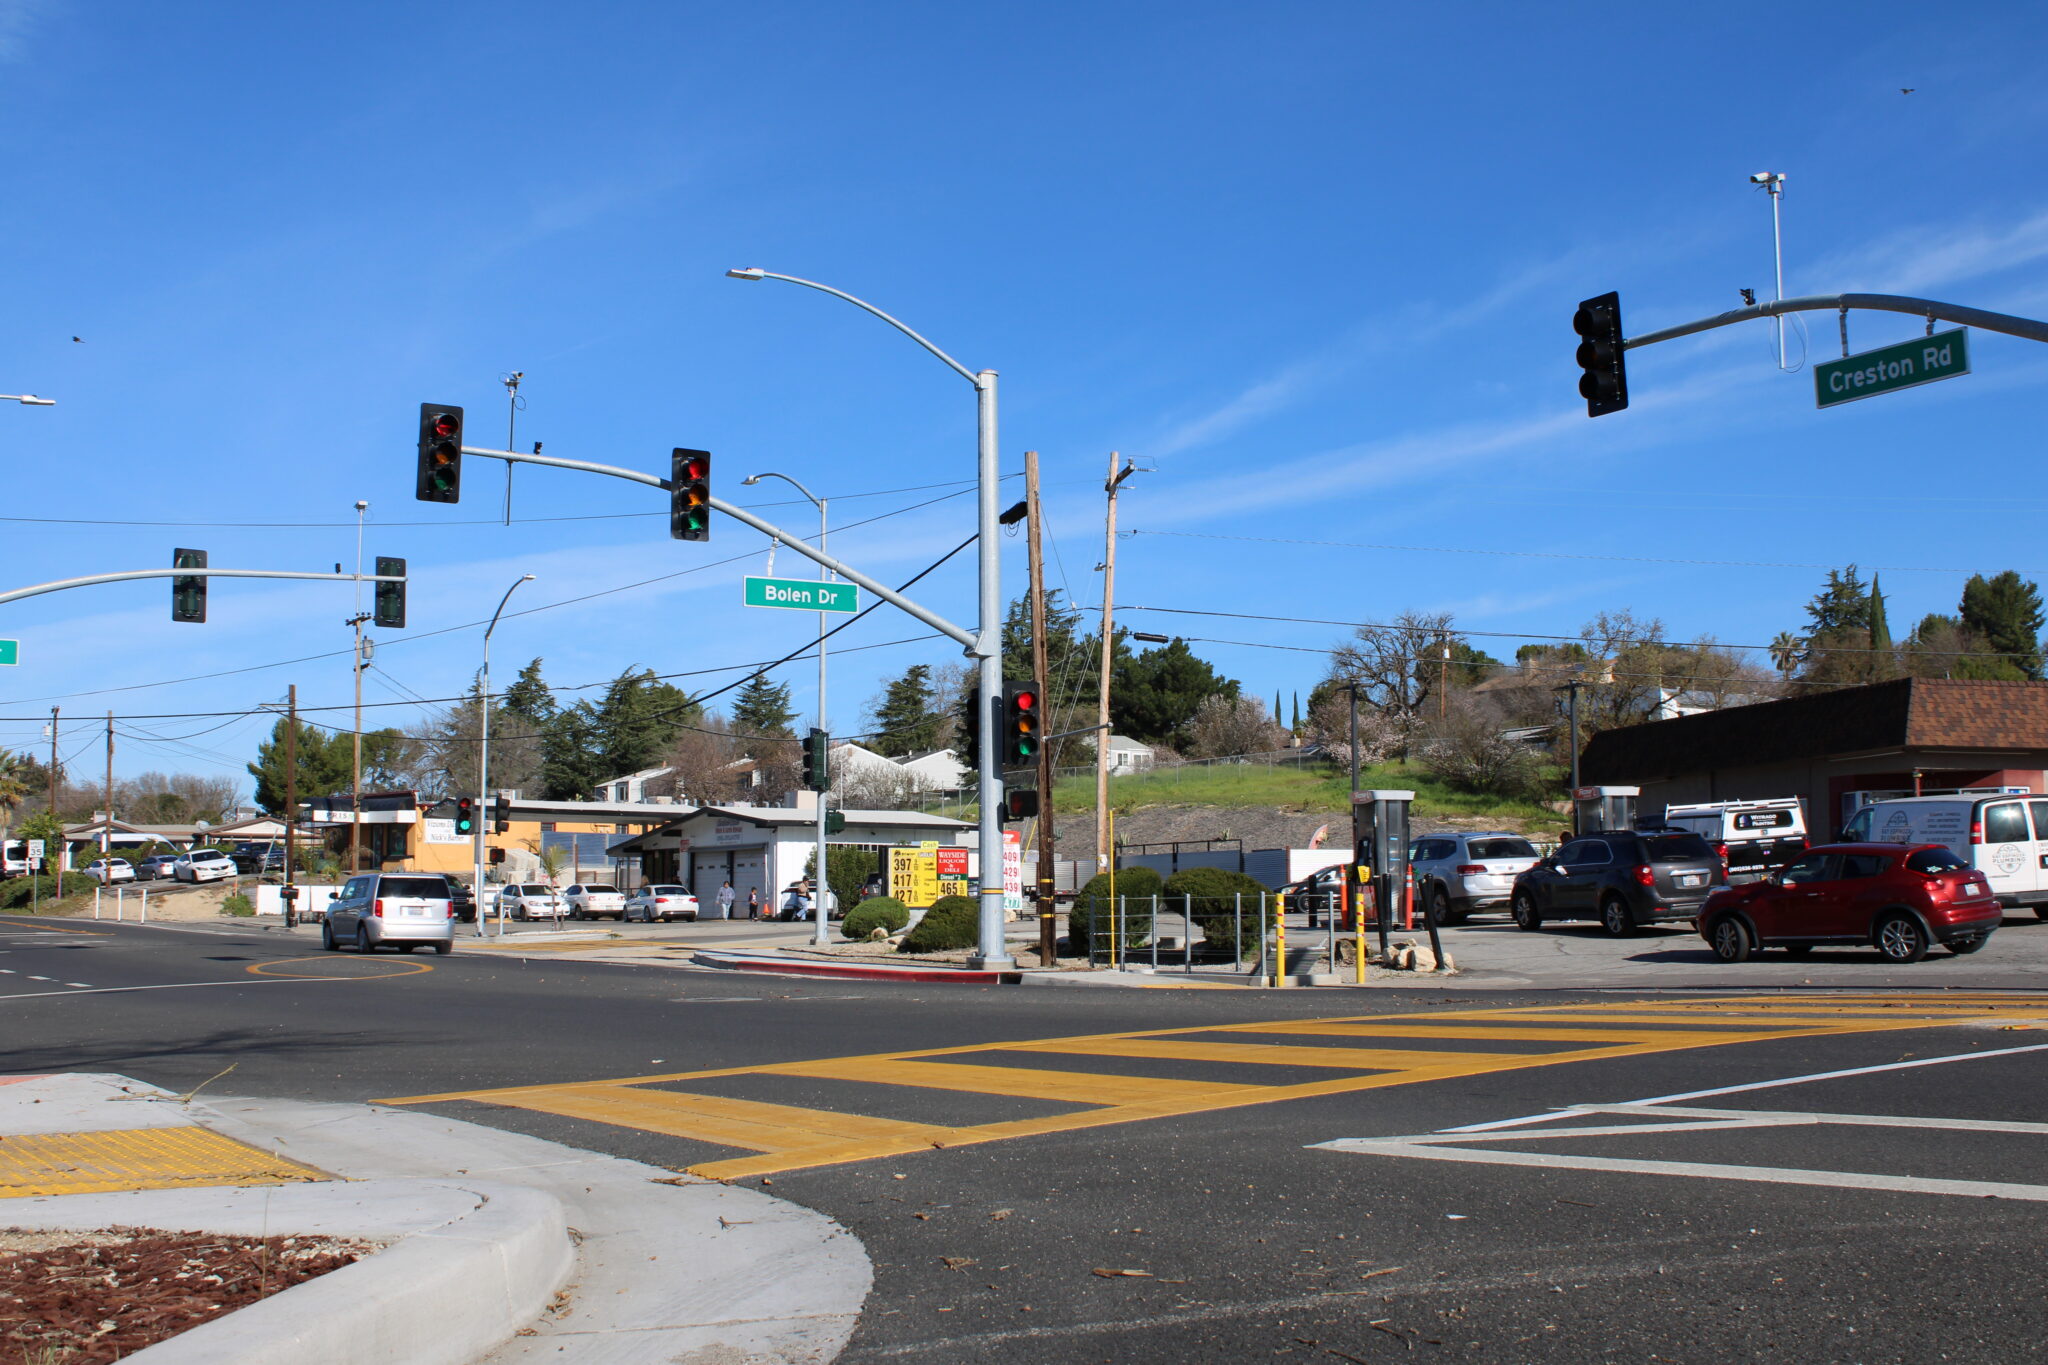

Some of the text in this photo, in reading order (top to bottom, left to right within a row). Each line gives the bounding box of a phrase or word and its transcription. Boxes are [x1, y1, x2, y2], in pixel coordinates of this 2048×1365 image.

[1829, 343, 1952, 393] Creston Rd
[765, 585, 838, 605] Bolen Dr
[30, 848, 42, 856] 35
[1003, 852, 1017, 862] 409
[894, 858, 911, 871] 397
[1003, 867, 1018, 877] 429
[894, 874, 911, 887] 417
[941, 883, 958, 895] 465
[1004, 882, 1018, 892] 439
[894, 890, 912, 902] 427
